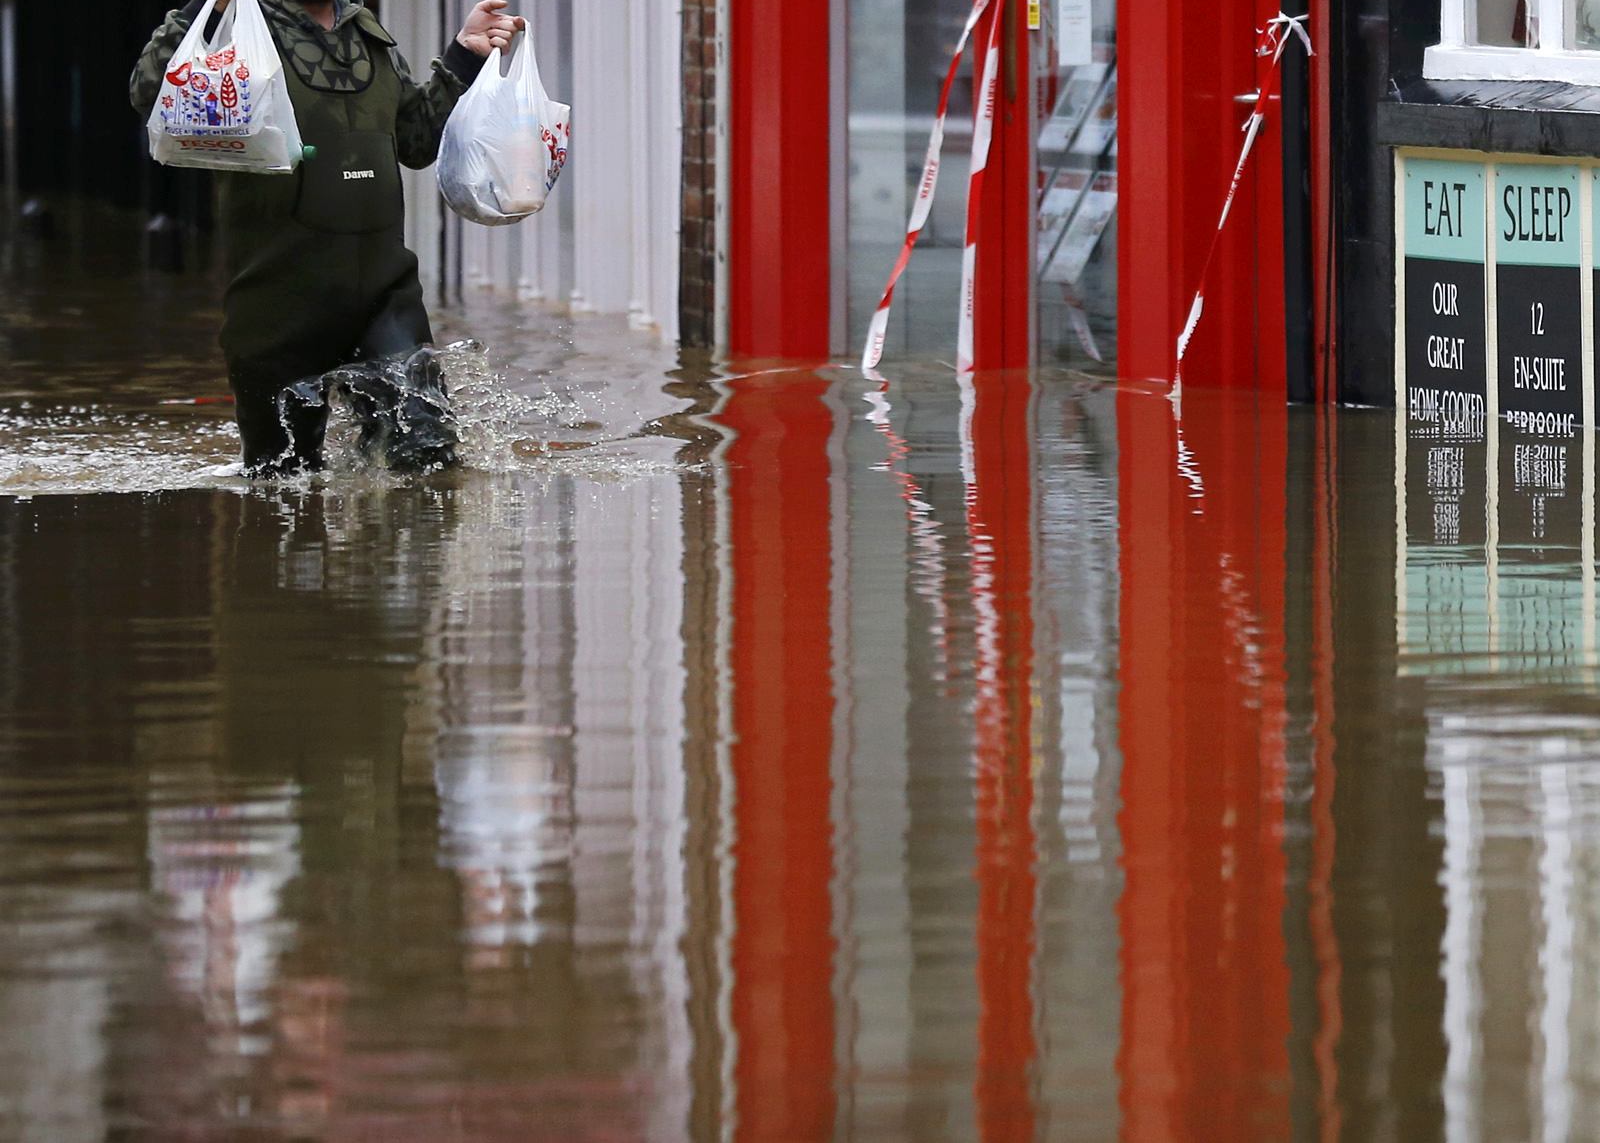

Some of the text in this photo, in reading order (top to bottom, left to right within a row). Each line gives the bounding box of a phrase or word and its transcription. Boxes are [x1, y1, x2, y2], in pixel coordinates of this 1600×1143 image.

[176, 139, 246, 150] TESCO
[1424, 180, 1466, 237] EAT
[1503, 184, 1571, 242] SLEEP
[1433, 282, 1459, 316] OUR
[1530, 302, 1544, 335] 12
[1427, 336, 1465, 371] GREAT
[1514, 356, 1567, 391] EN-SUITE
